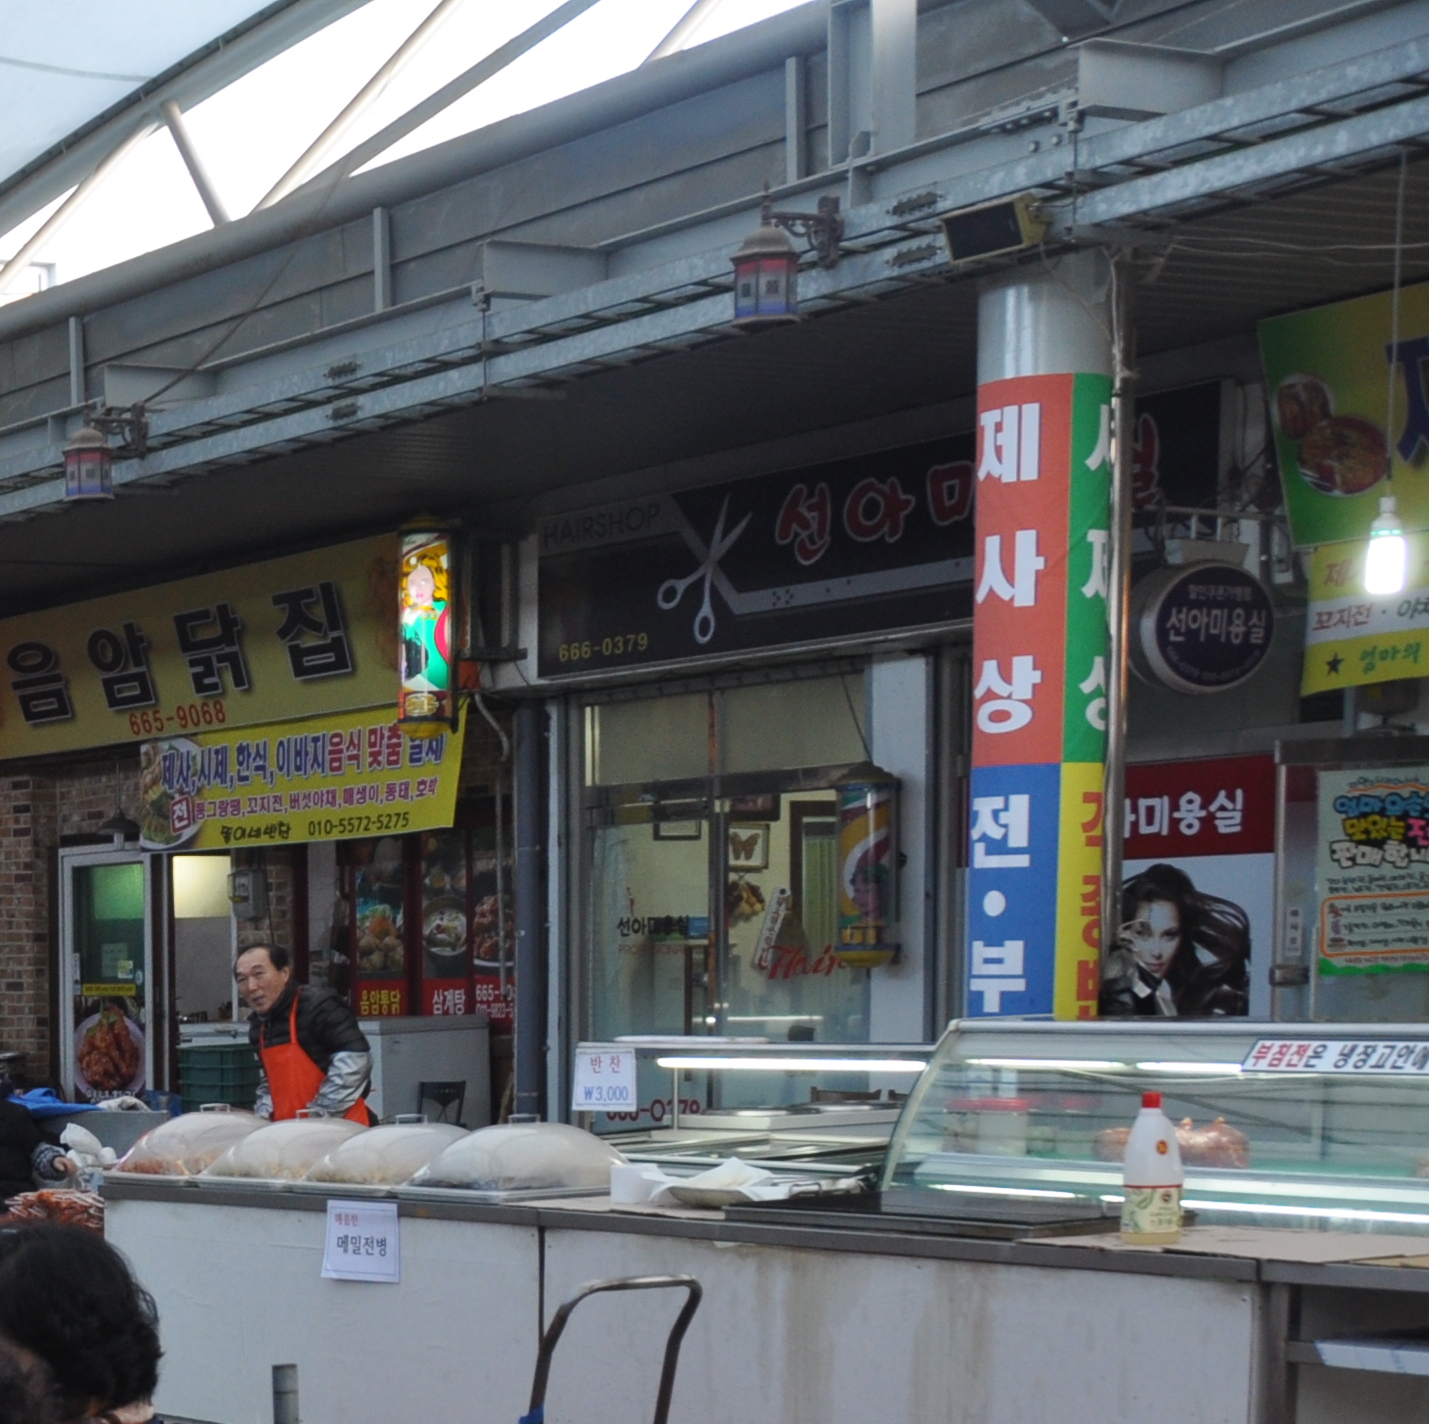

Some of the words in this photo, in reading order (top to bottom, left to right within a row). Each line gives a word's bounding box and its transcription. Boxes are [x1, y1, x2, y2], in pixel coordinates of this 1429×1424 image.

[543, 503, 661, 547] HAIRSHOP
[974, 402, 1045, 735] 제사상
[1166, 606, 1266, 645] 선아미용실
[6, 581, 354, 727] 음암닭집
[558, 632, 649, 662] 666-0379
[129, 700, 227, 737] 665-9068
[308, 810, 410, 837] 010-5572-5275
[617, 914, 689, 938] 선아미용실
[432, 988, 466, 1015] 삼계탕
[590, 1053, 622, 1075] 반찬
[1251, 1042, 1329, 1069] 부침전은
[336, 1233, 388, 1257] 메밀전병
